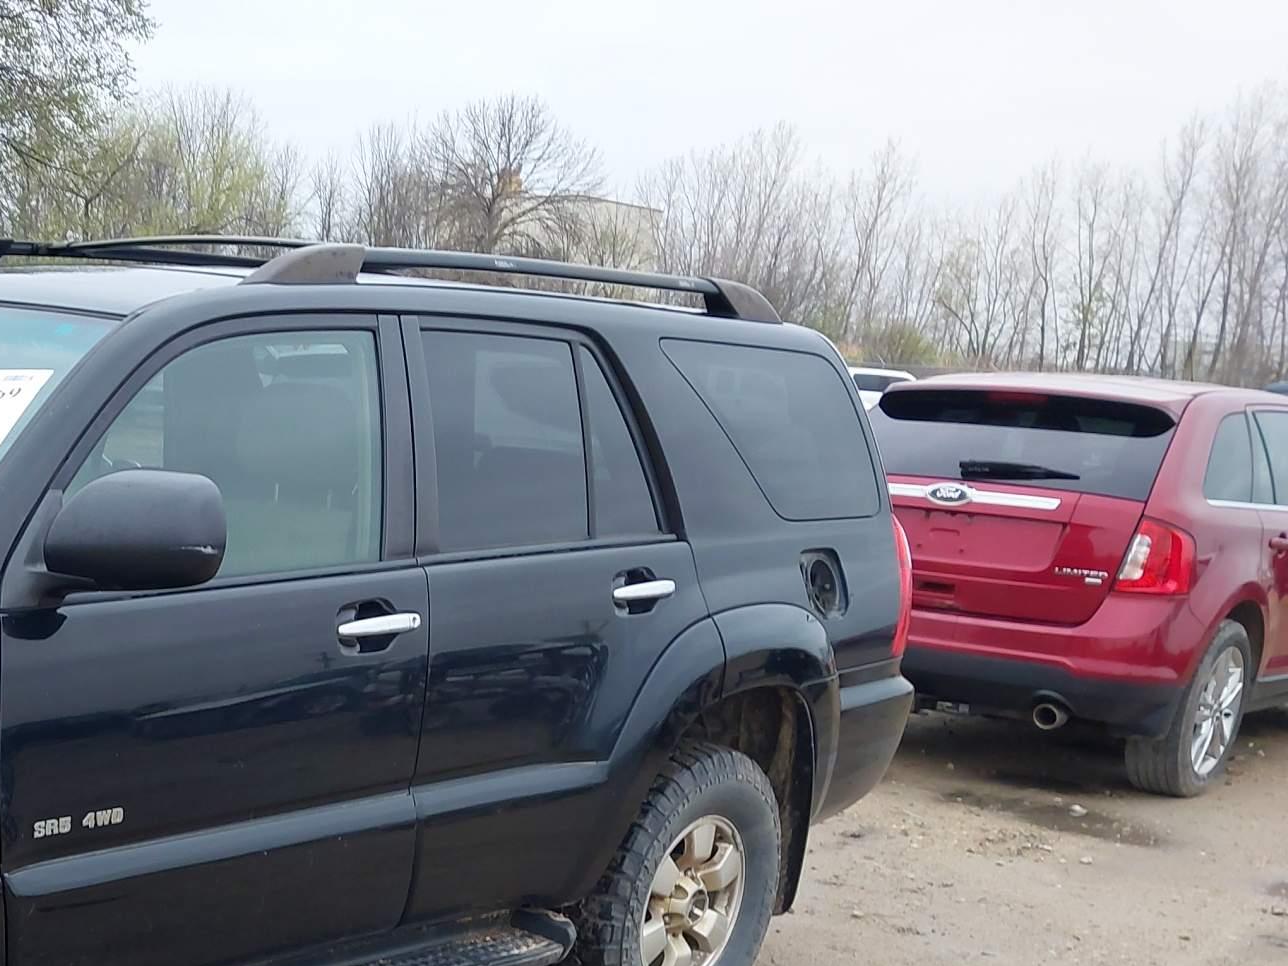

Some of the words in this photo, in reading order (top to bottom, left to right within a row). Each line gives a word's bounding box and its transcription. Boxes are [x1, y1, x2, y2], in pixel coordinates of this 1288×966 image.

[935, 485, 962, 499] Ford
[1054, 566, 1109, 579] LIMITED
[33, 816, 73, 839] SR5
[81, 807, 125, 829] 4WD
